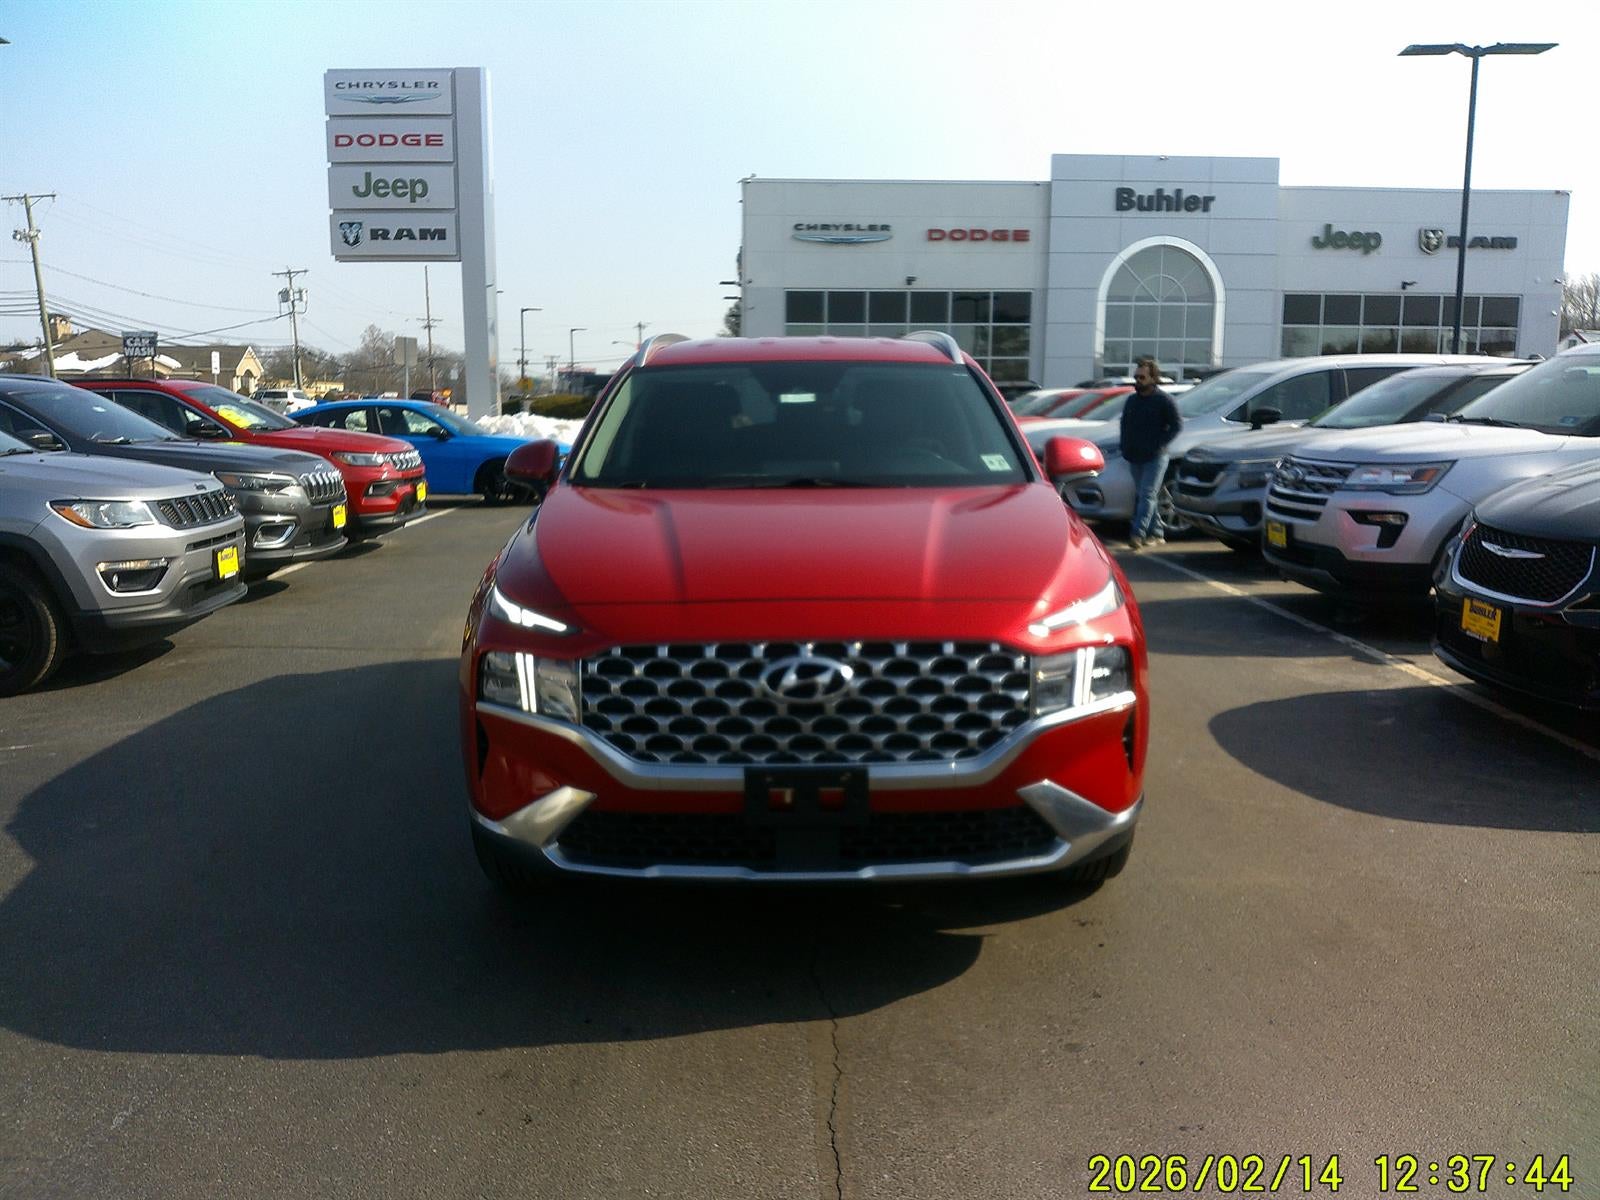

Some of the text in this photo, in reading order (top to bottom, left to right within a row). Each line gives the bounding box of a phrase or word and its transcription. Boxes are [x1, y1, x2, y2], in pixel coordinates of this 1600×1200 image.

[335, 81, 439, 90] CHRYSLER
[334, 134, 443, 147] DODGE
[352, 172, 429, 203] Jeep
[1115, 187, 1216, 212] Buhler
[793, 223, 892, 232] CHRYSLER
[370, 228, 447, 241] RAM
[927, 229, 1031, 241] DODGE
[1311, 223, 1383, 255] Jeep
[126, 337, 150, 346] CAR
[124, 346, 155, 356] WASH
